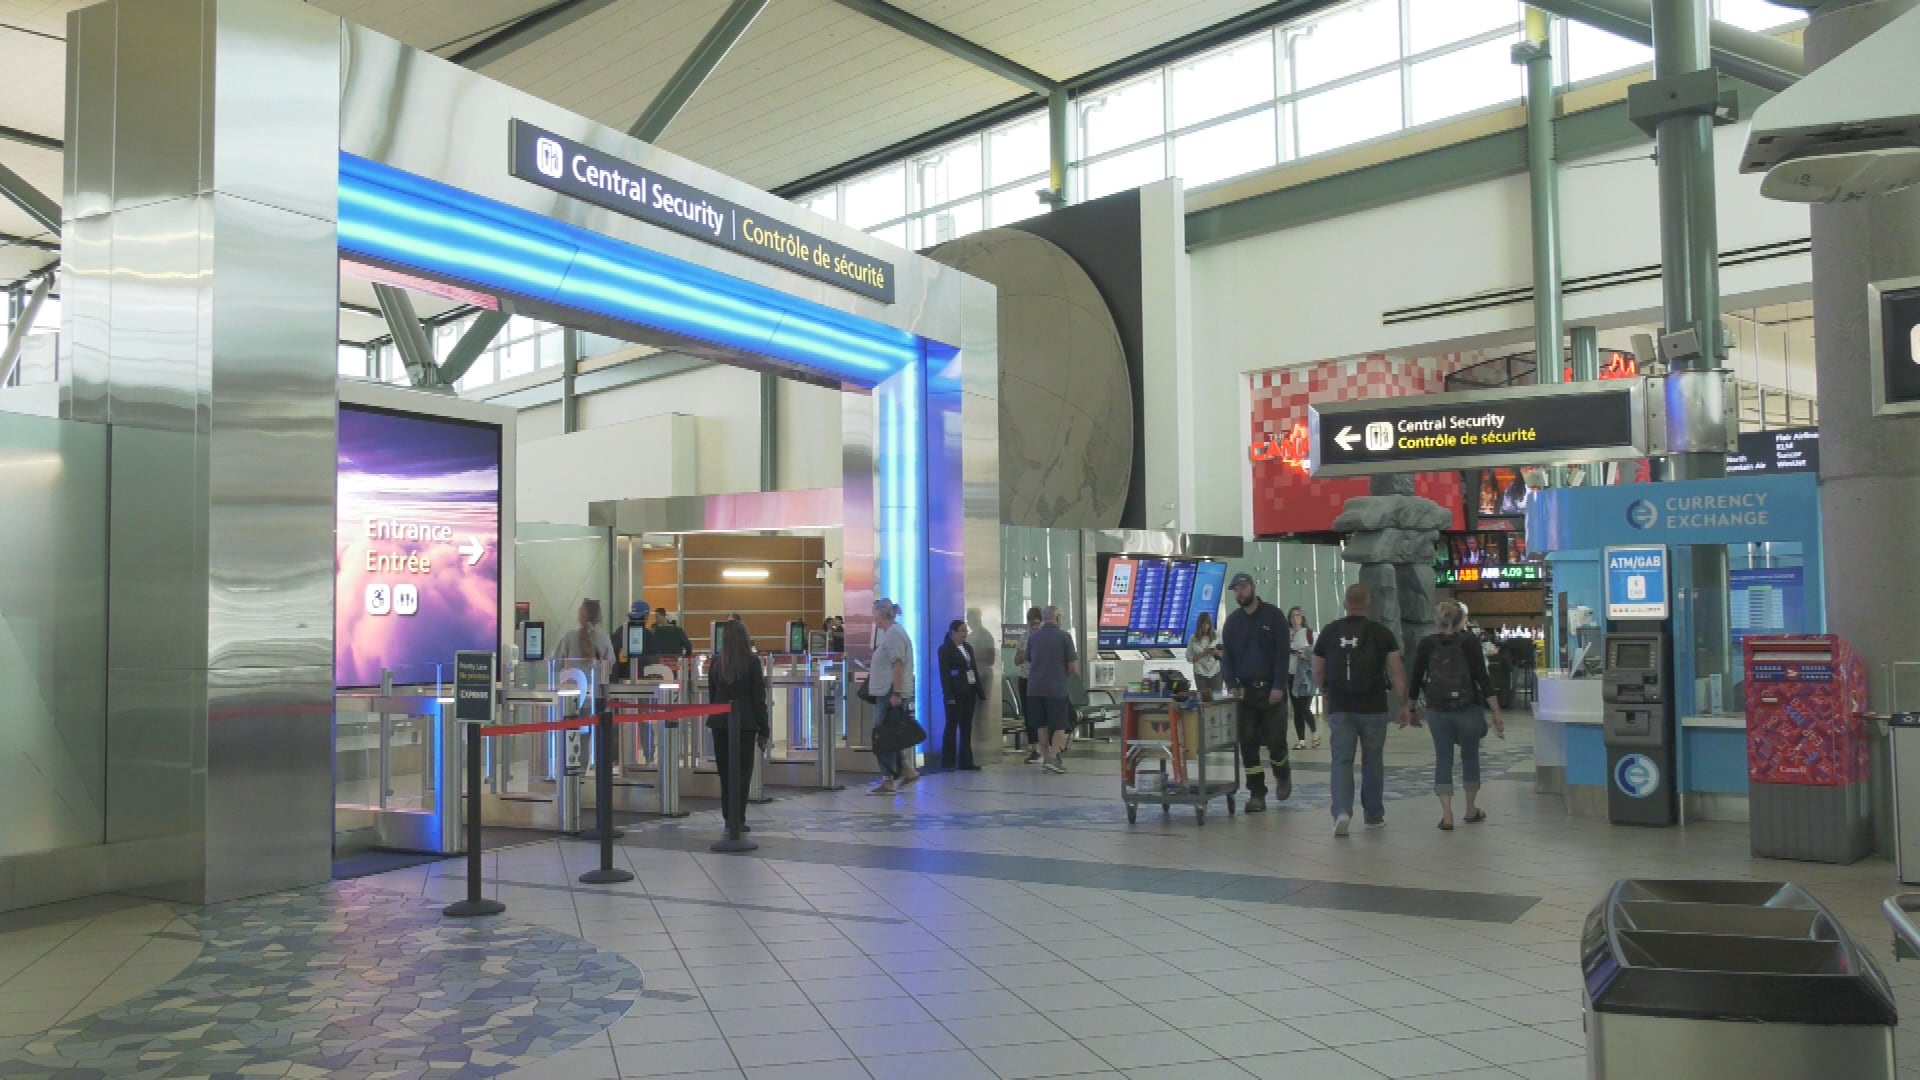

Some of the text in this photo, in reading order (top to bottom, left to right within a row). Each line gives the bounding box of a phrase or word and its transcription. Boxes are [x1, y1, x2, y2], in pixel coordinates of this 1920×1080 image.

[572, 155, 885, 289] Central Security Contrôle de sécurité
[1397, 412, 1506, 433] Central Security
[1397, 427, 1537, 449] Contrôle de sécurité
[1665, 492, 1768, 511] CURRENCY
[366, 517, 453, 543] Entrance
[1666, 511, 1769, 529] EXCHANGE
[366, 549, 432, 574] Entrée
[1609, 555, 1661, 569] ATM/GAB
